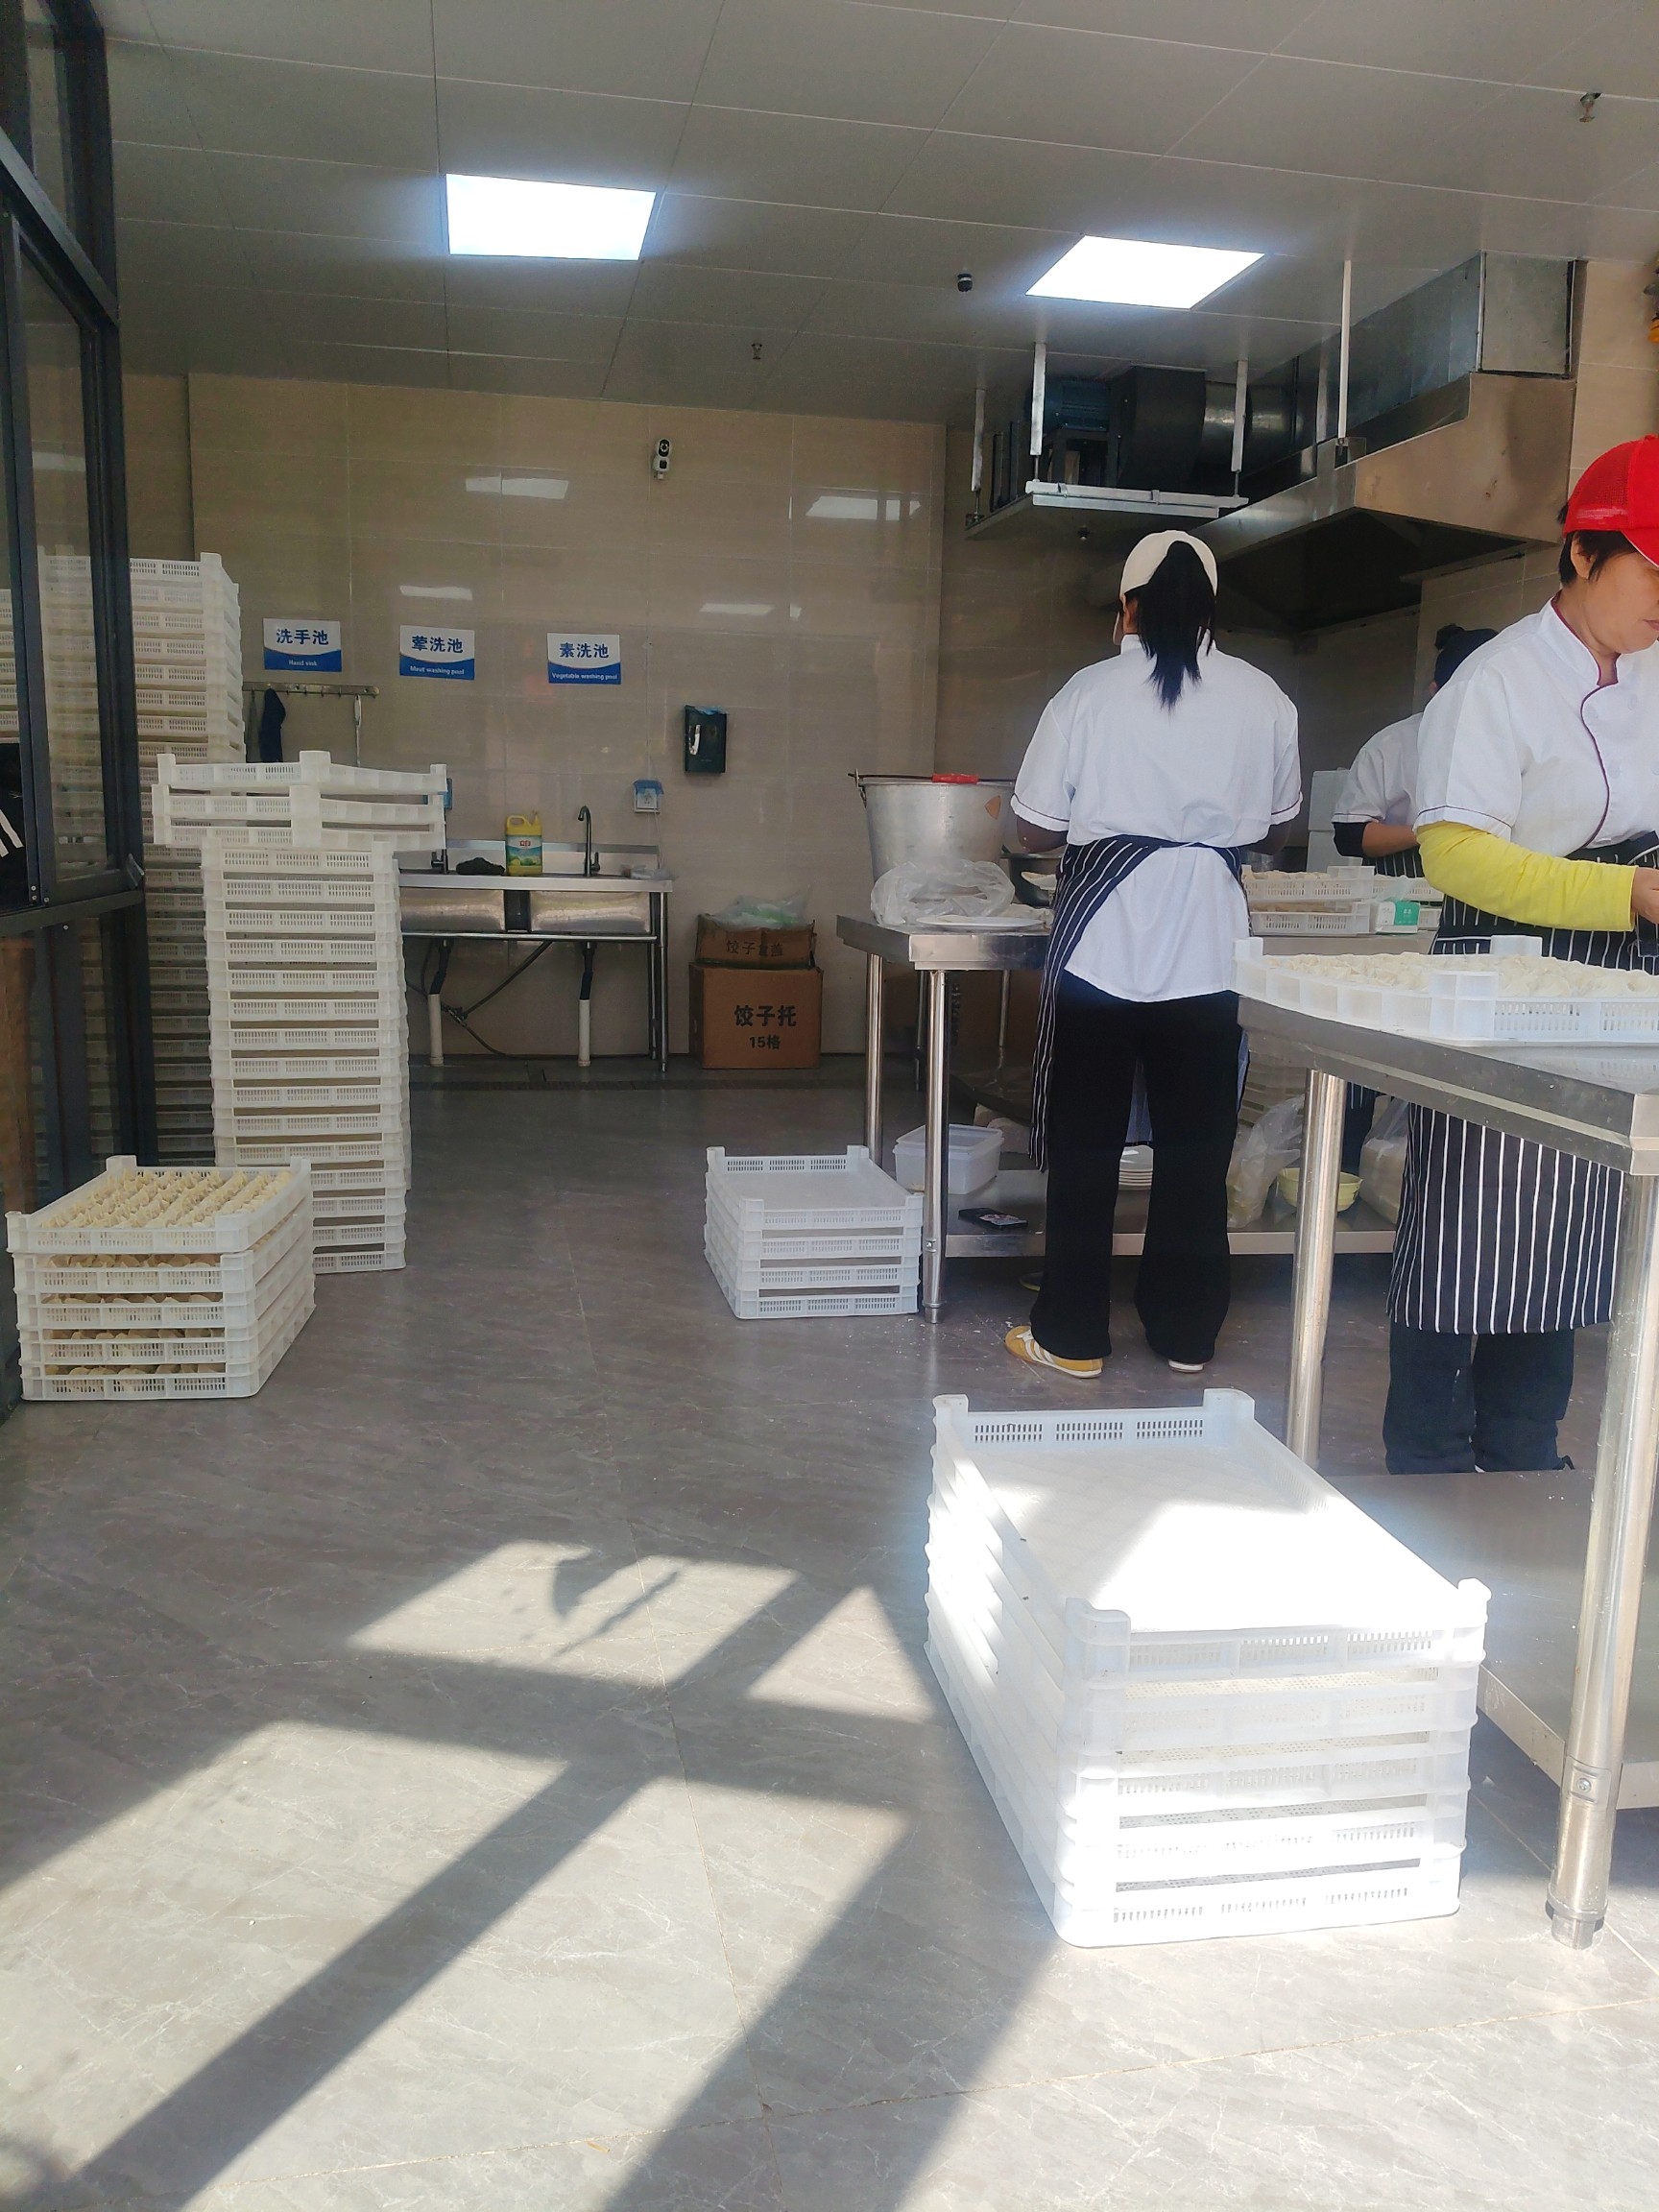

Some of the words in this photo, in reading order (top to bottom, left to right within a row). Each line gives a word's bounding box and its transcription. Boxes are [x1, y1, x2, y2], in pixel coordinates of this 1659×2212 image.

[276, 628, 329, 645] 洗手池
[411, 635, 464, 653] 荤洗池
[559, 641, 610, 659] 素洗池
[426, 666, 450, 675] washing
[733, 1004, 797, 1027] 饺子托
[749, 1034, 781, 1049] 15格
